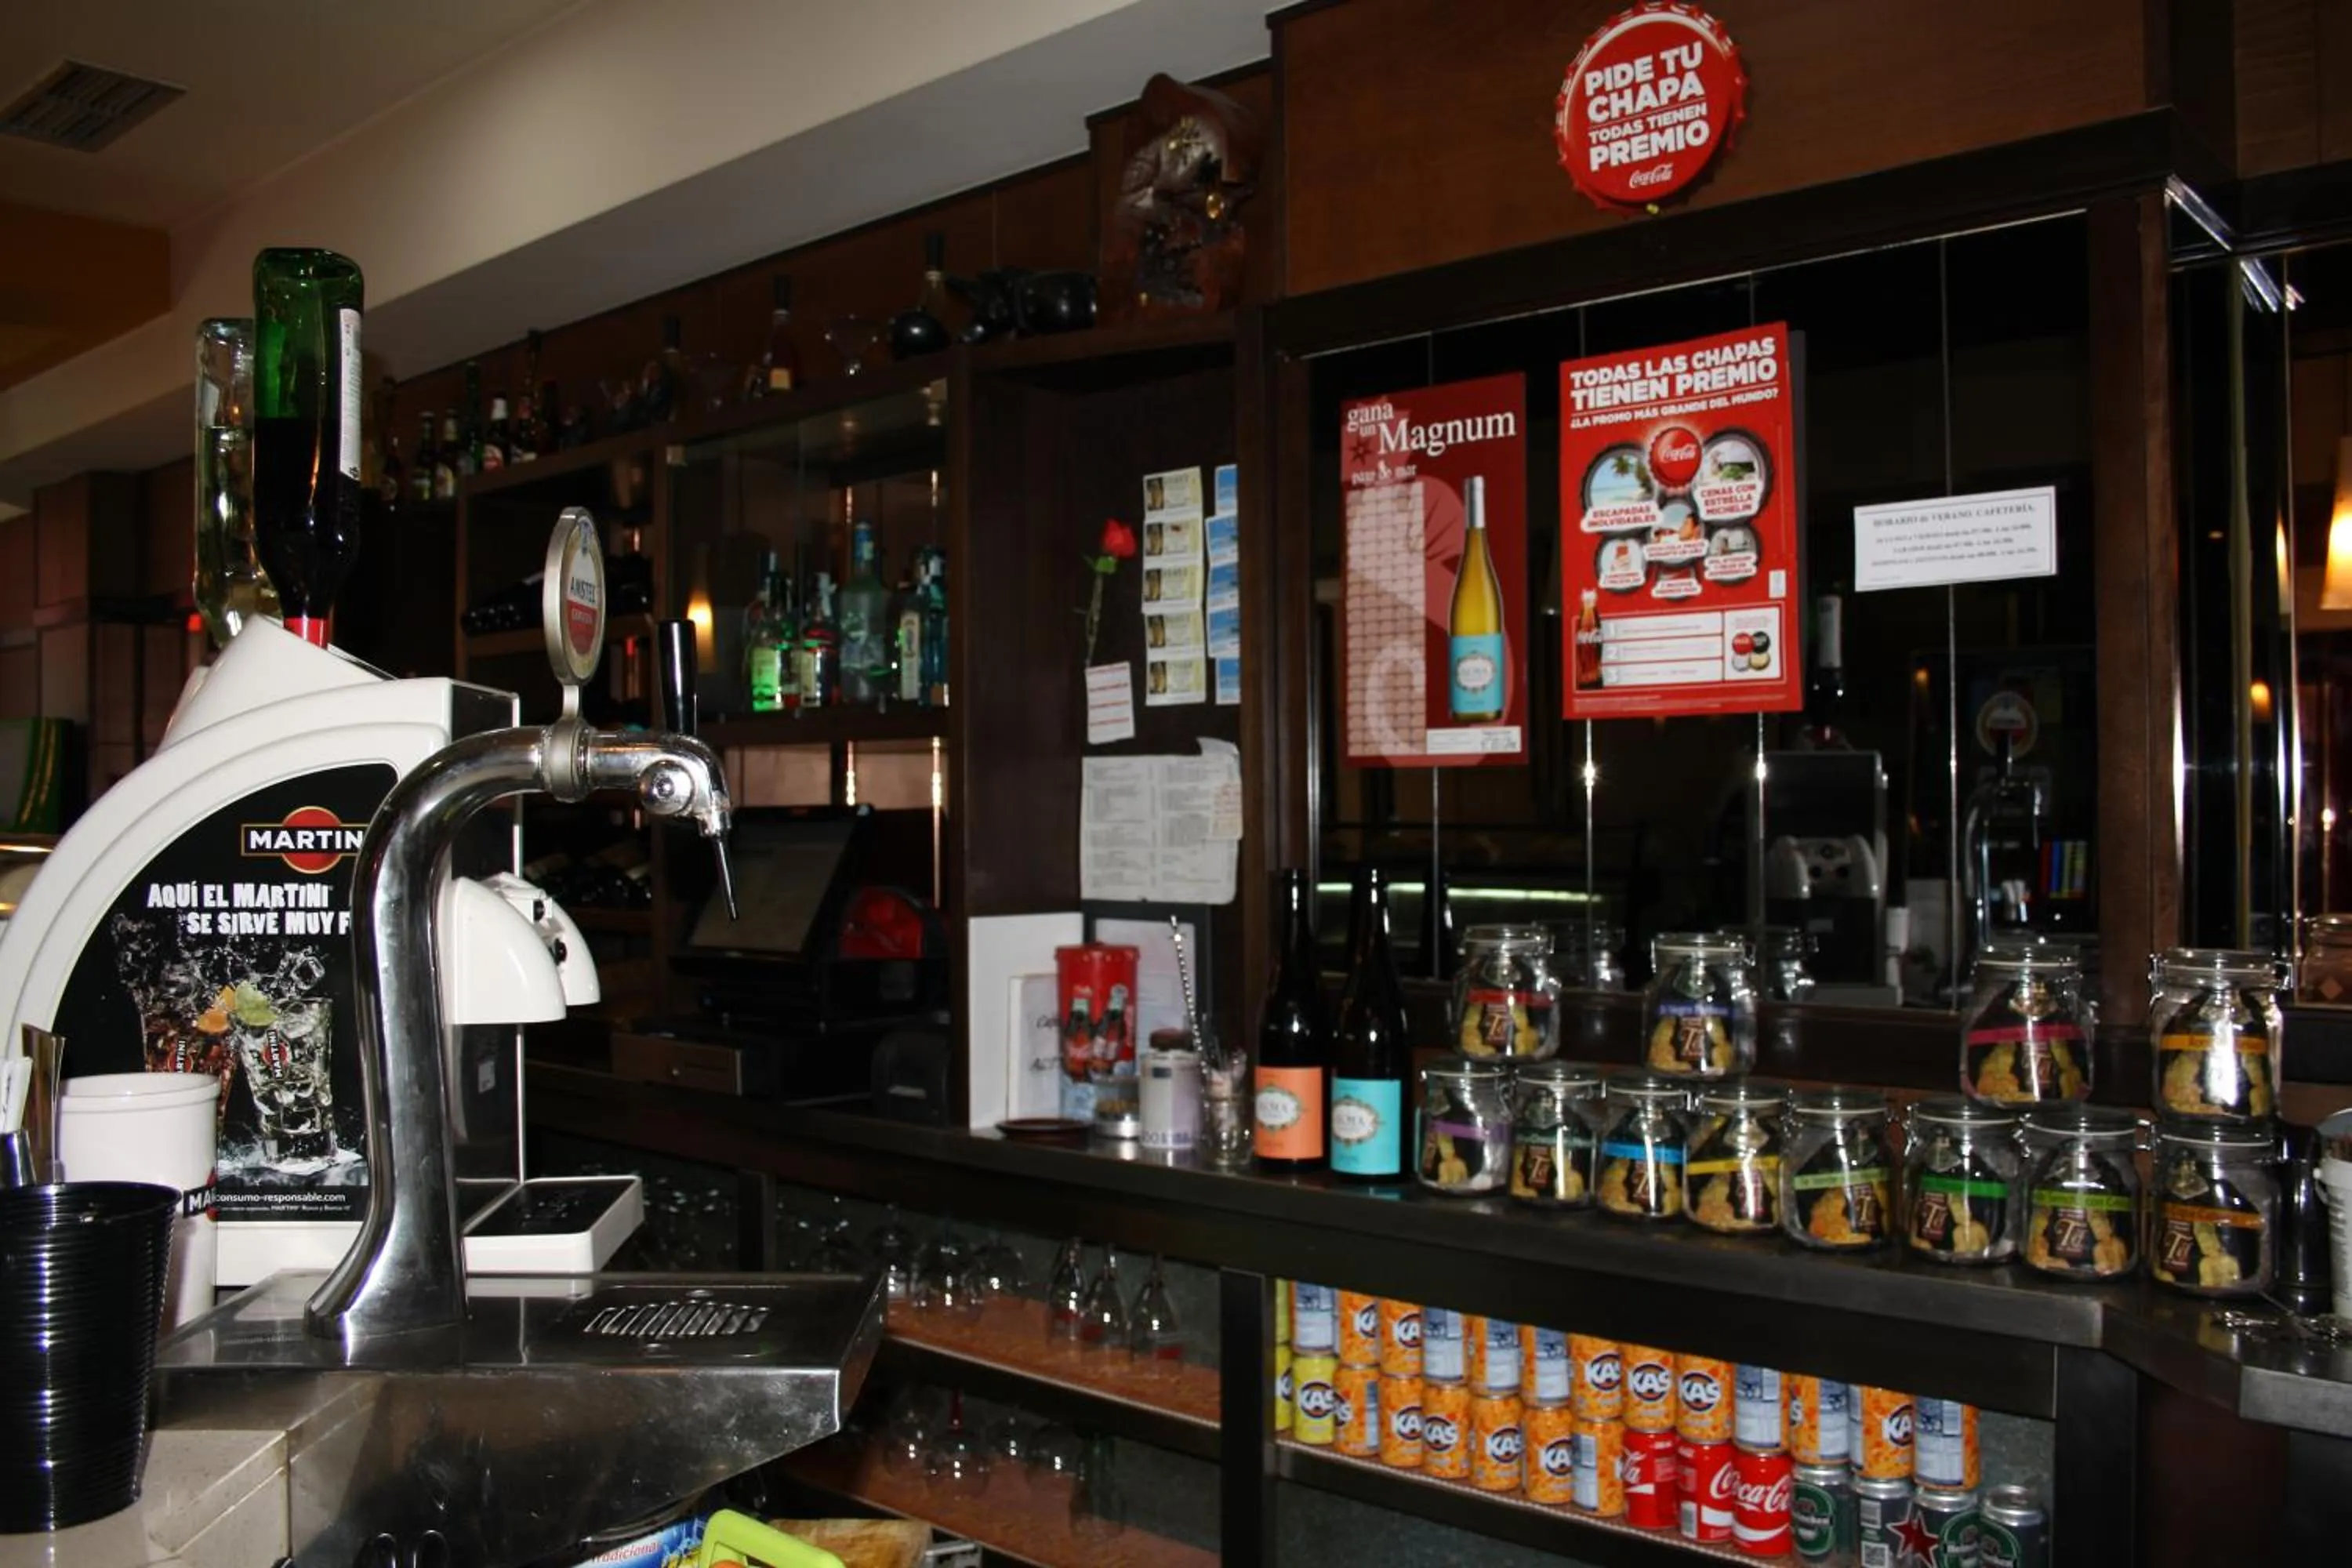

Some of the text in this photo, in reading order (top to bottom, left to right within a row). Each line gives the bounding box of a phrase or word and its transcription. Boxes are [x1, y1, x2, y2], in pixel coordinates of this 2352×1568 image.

[1584, 42, 1703, 96] PIDE TU
[1588, 71, 1705, 123] CHAPA
[1589, 103, 1708, 144] TODAS TIENEN
[1589, 120, 1710, 172] PREMIO
[1570, 337, 1776, 390] TODAS LAS CHAPAS
[1570, 358, 1777, 411] TIENEN PREMIO
[1347, 402, 1394, 432] gana
[1592, 412, 1632, 426] PROMO
[1661, 400, 1708, 415] GRANDE
[1709, 397, 1730, 407] DEL
[1359, 411, 1517, 457] un Magnum
[1592, 506, 1651, 518] ESCAPADAS
[1704, 493, 1753, 506] ESTRELLA
[1932, 510, 1973, 523] VERANO
[249, 830, 363, 849] MARTIN
[147, 875, 329, 908] AQUÍ EL MARTINI
[187, 913, 212, 935] SE
[217, 911, 278, 935] SIRVE
[285, 912, 334, 935] MUY
[176, 1040, 185, 1073] RTINI
[268, 1031, 282, 1079] MARTINI
[1393, 1322, 1421, 1341] KA
[1628, 1370, 1671, 1392] KAS
[1679, 1380, 1721, 1402] KAS
[1393, 1412, 1421, 1435] KA
[1425, 1422, 1458, 1444] KAS
[1884, 1416, 1912, 1438] KA
[1541, 1446, 1570, 1466] KA
